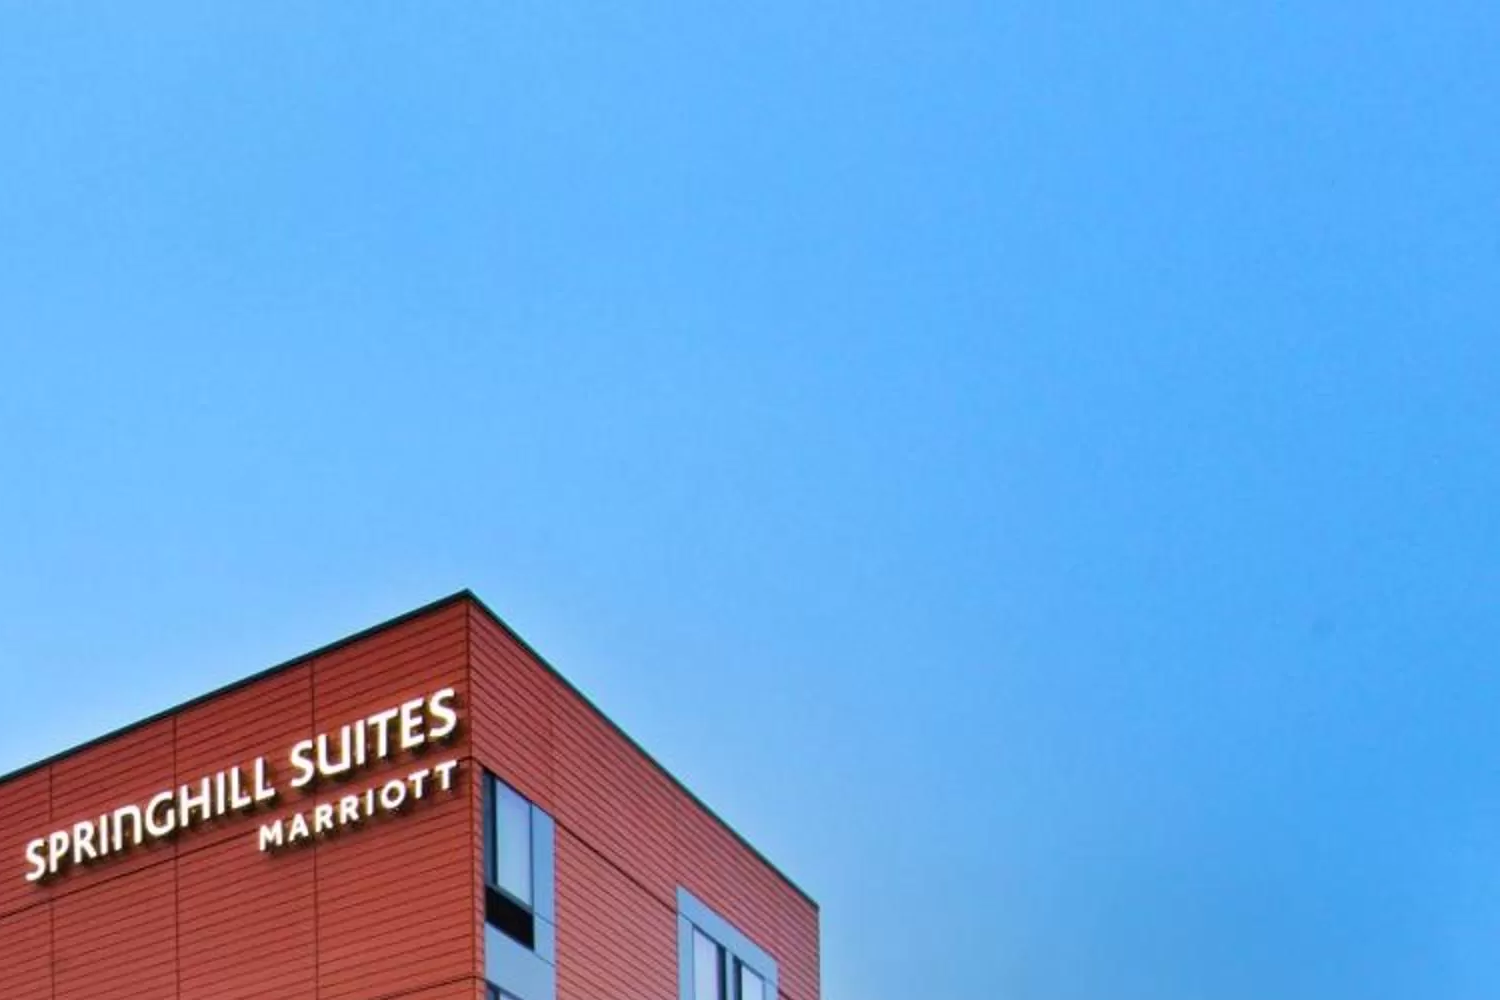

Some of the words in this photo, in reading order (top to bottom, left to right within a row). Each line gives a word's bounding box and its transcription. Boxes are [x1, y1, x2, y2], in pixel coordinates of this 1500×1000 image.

[25, 757, 275, 882] SPRINGHILL
[290, 687, 457, 787] SUITES
[259, 759, 457, 851] MARRIOTT
